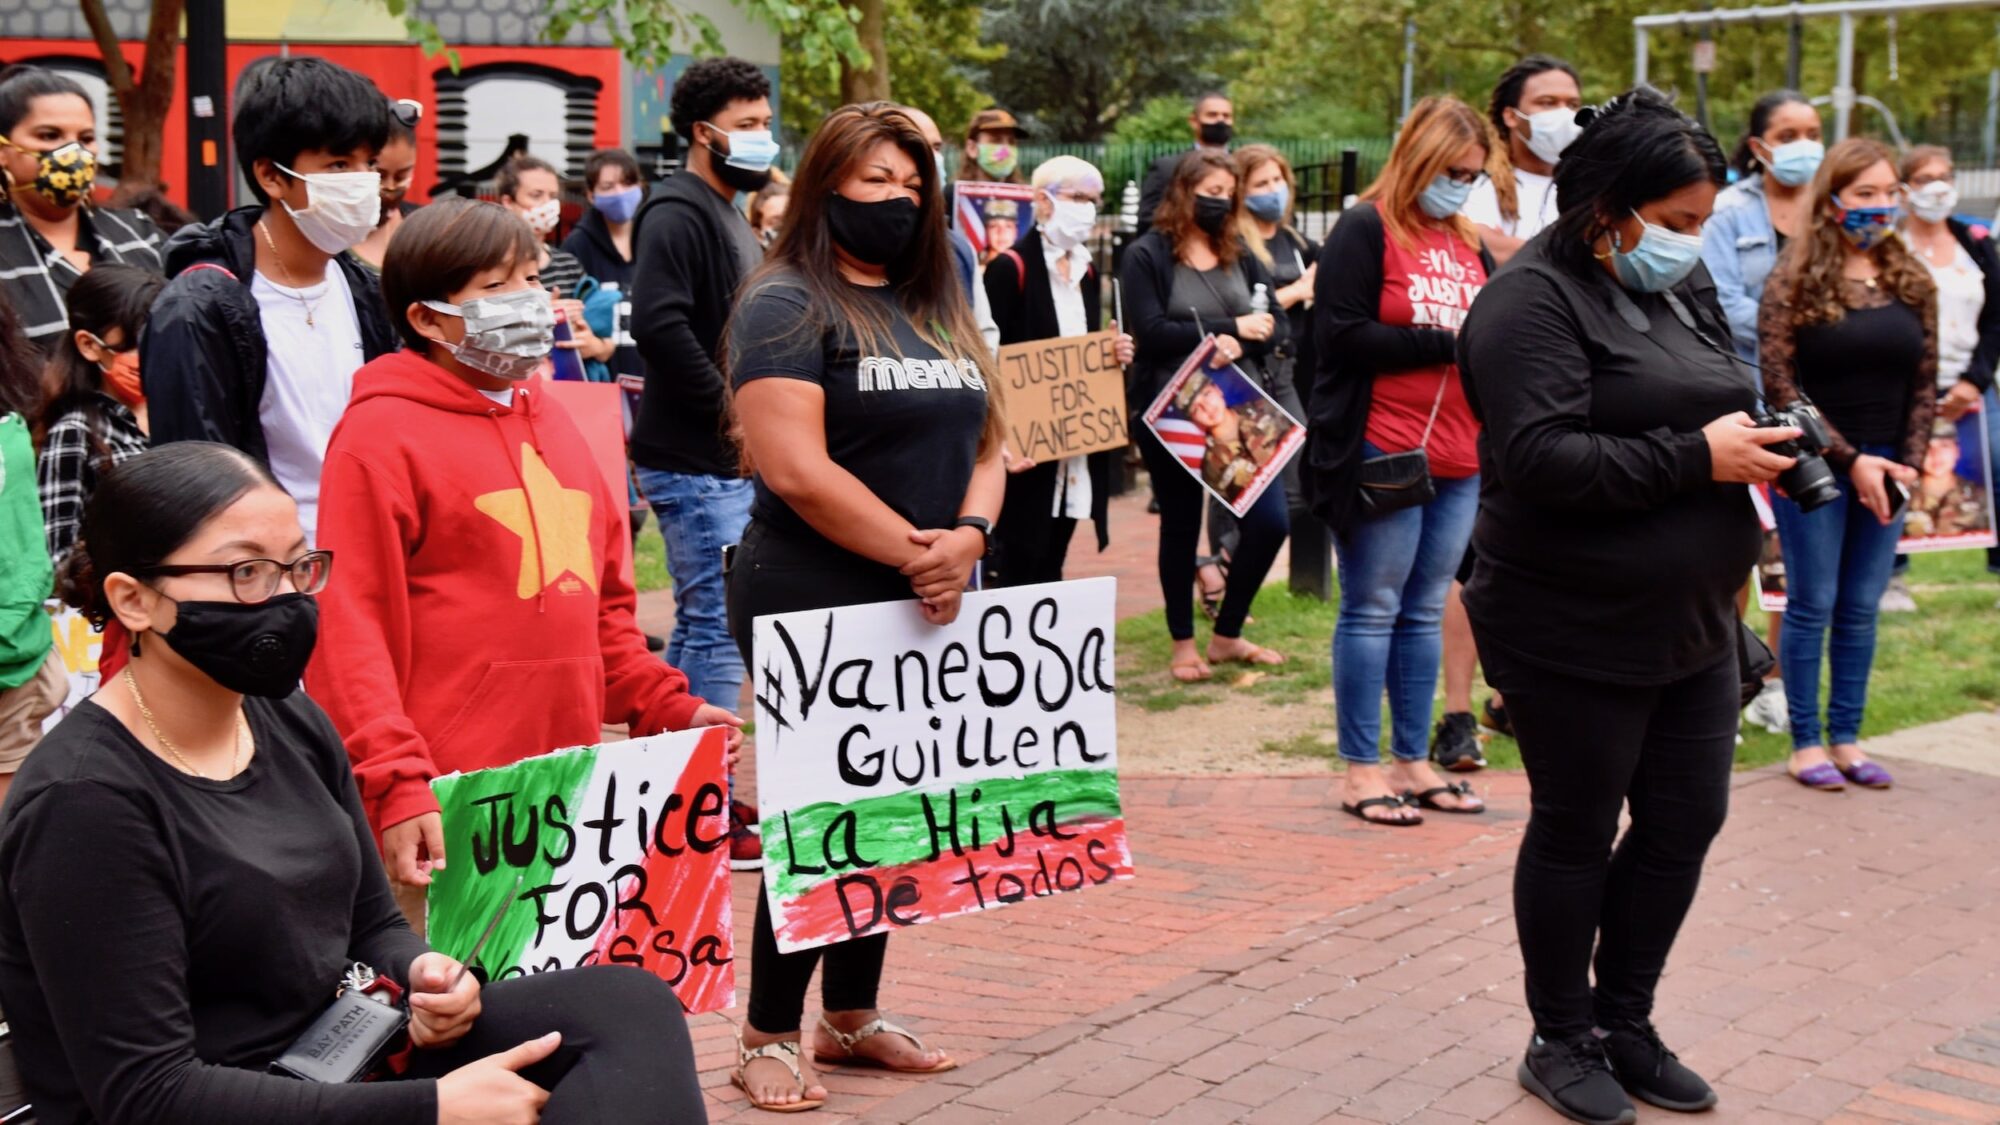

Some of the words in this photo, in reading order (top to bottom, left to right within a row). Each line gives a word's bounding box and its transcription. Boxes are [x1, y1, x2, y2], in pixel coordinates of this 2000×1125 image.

[1006, 337, 1118, 389] JUSTICE
[1051, 380, 1095, 414] FOR
[1012, 406, 1129, 458] VANESSA
[784, 810, 879, 876] La
[921, 788, 1078, 862] Hija
[518, 864, 659, 948] FOR
[835, 874, 922, 936] De
[953, 839, 1115, 909] todos
[307, 1034, 331, 1058] BAY
[331, 1005, 365, 1035] PATH
[327, 1014, 379, 1066] UNIVERSITY
